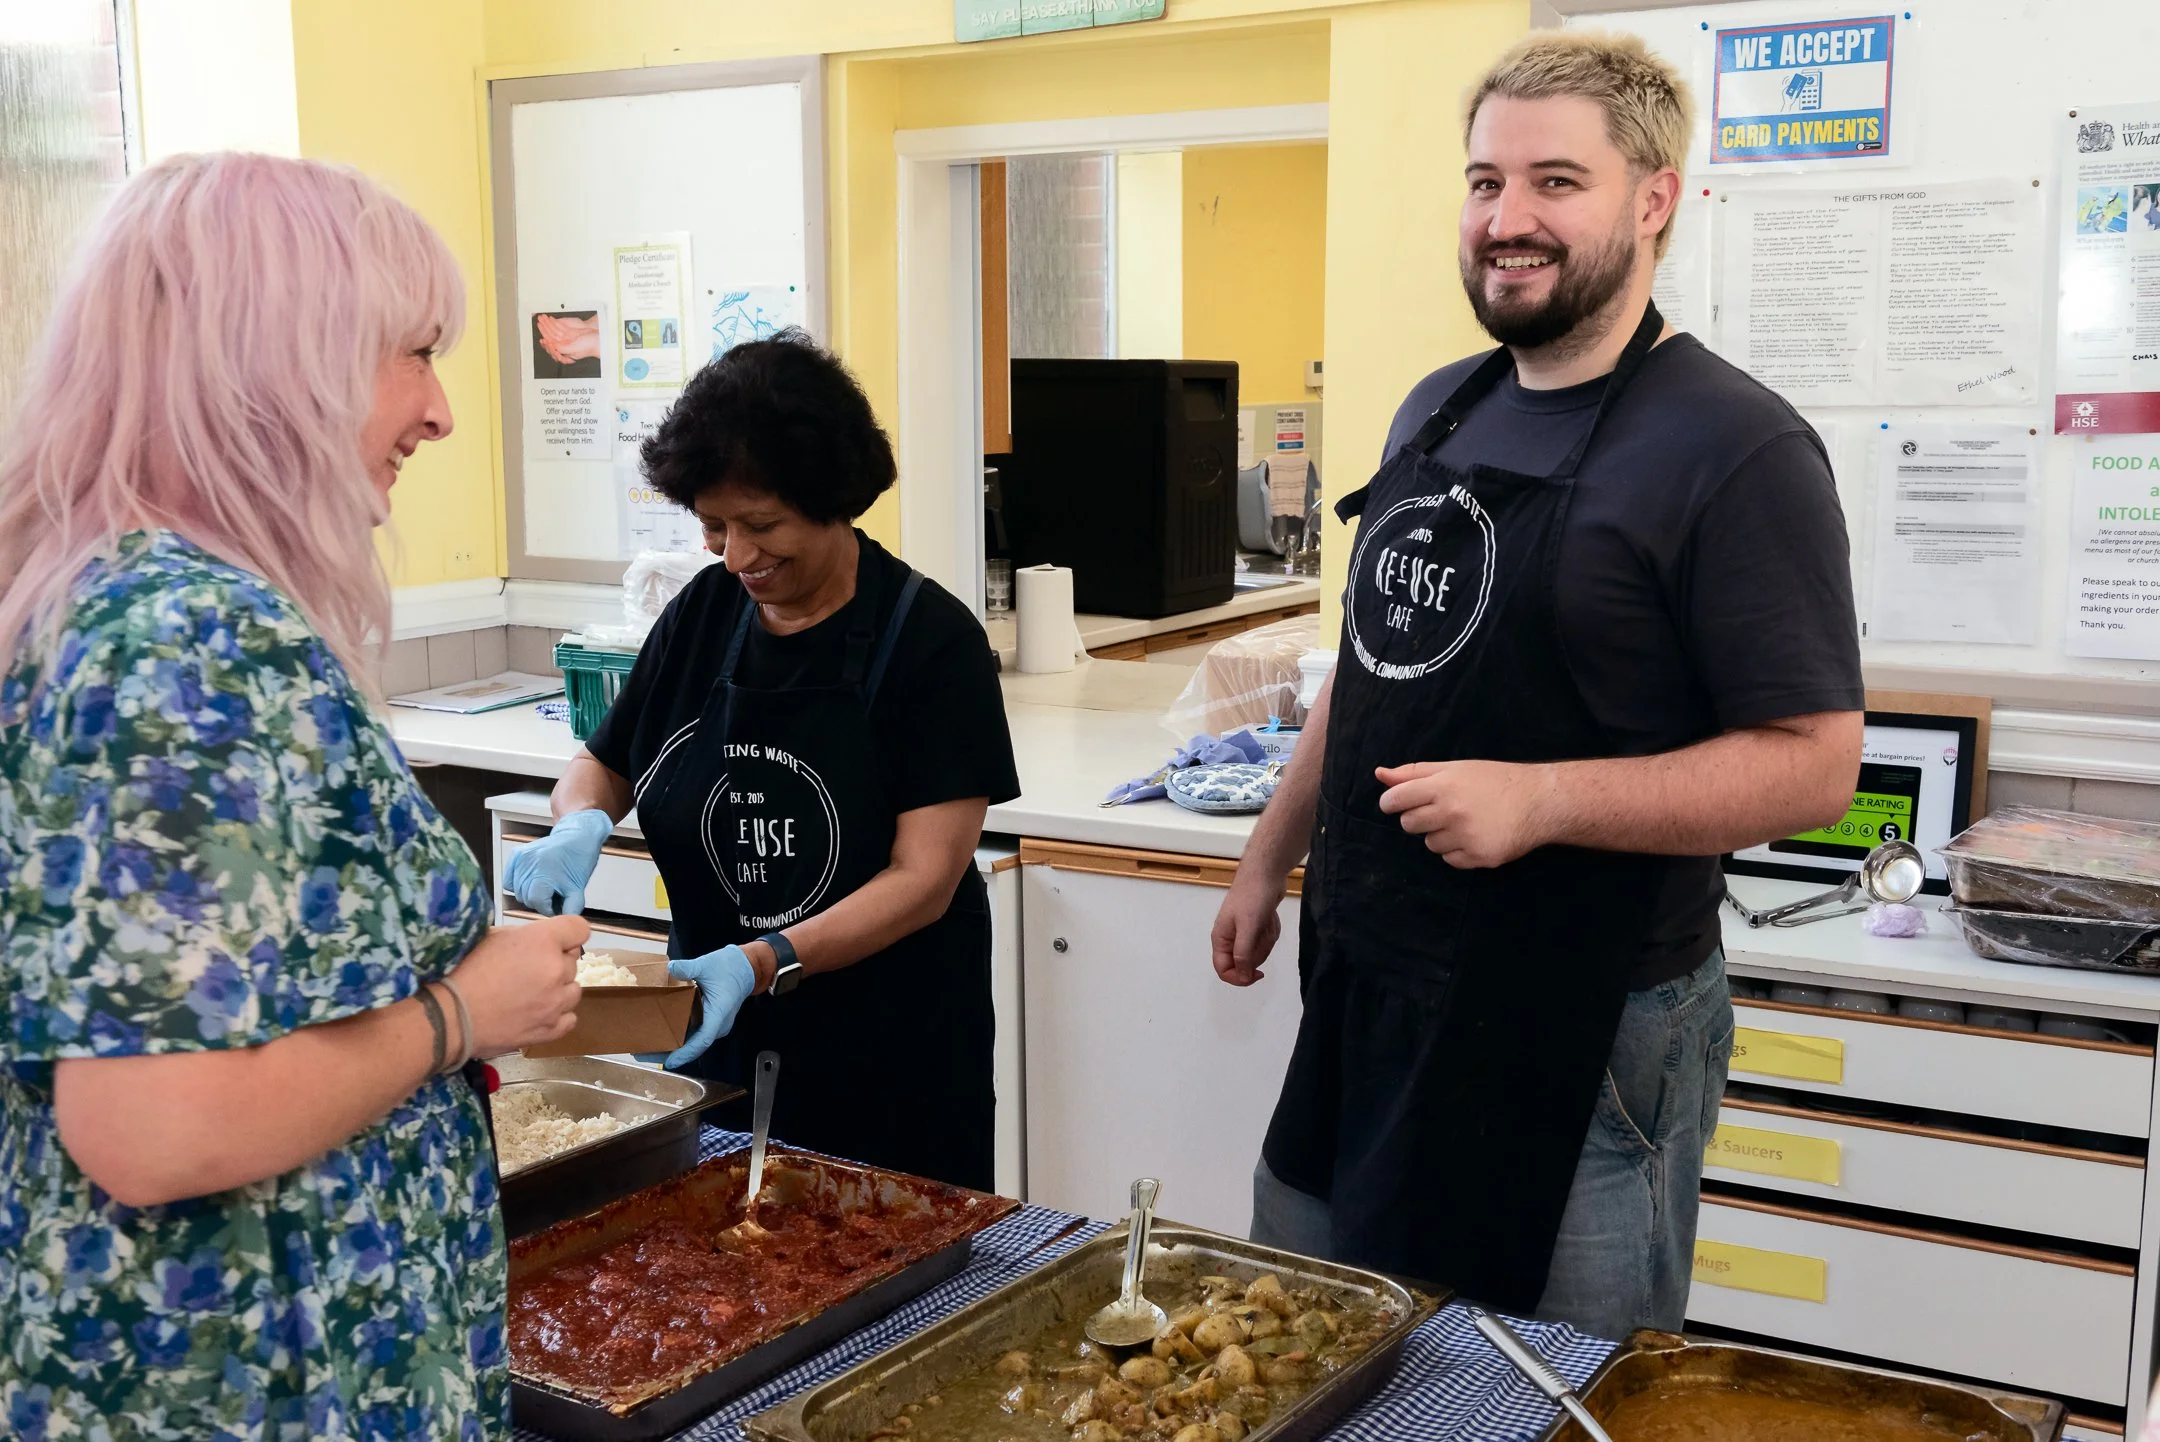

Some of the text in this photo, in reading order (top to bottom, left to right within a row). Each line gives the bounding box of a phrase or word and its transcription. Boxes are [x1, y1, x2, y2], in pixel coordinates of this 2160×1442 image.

[1734, 27, 1876, 69] WE ACCEPT
[2122, 120, 2150, 131] Health
[1722, 116, 1879, 149] CARD PAYMENTS
[2122, 130, 2160, 146] What
[1852, 194, 1878, 203] GIFTS
[1880, 192, 1905, 201] FROM
[1906, 192, 1926, 200] GOD
[620, 254, 641, 265] Pledge
[1957, 365, 2016, 393] Ethel Wood
[540, 388, 556, 396] Open
[562, 407, 583, 416] yourself
[570, 417, 582, 425] And
[583, 417, 598, 425] show
[2071, 418, 2099, 428] HSE
[558, 427, 588, 436] willingness
[618, 432, 637, 442] Food
[2092, 456, 2143, 470] FOOD
[1448, 484, 1481, 522] WASTE
[2098, 506, 2160, 521] INTOLE
[2100, 538, 2131, 546] allergens
[2132, 548, 2140, 556] of
[2082, 577, 2110, 586] Please
[2112, 578, 2137, 587] speak
[2081, 590, 2160, 602] ingredients in your
[2080, 604, 2112, 614] making
[2135, 606, 2160, 614] order
[1386, 602, 1414, 632] CAFE
[2080, 620, 2126, 630] Thank you.
[1376, 662, 1428, 680] COMMUNITY
[1260, 743, 1281, 754] rilo
[764, 746, 799, 774] WASTE
[1879, 752, 1903, 760] bargain
[746, 792, 765, 804] 2015
[1866, 798, 1905, 810] RATING
[1884, 824, 1896, 842] 5
[737, 862, 768, 883] CAFE
[752, 904, 803, 929] COMMUNITY
[1722, 1138, 1783, 1161] Saucers
[1692, 1253, 1732, 1273] Mugs
